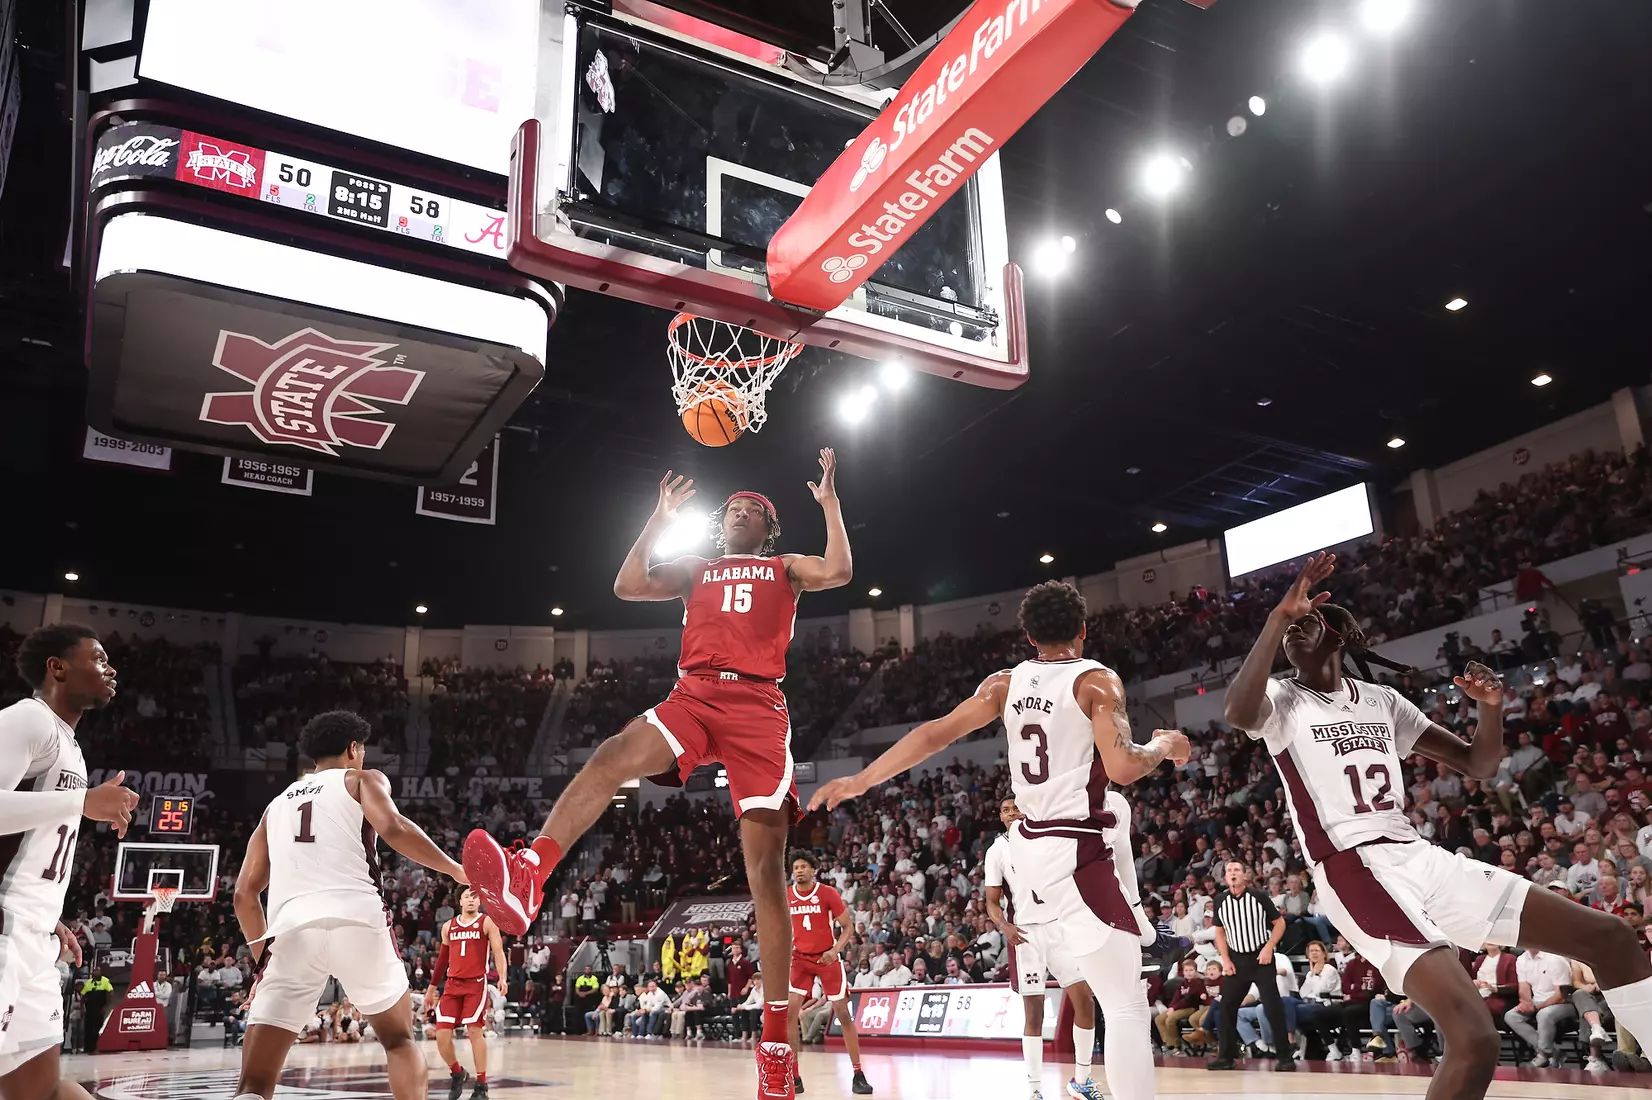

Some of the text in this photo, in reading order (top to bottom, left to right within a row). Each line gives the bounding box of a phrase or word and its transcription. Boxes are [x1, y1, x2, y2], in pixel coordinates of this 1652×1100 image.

[278, 163, 312, 187] 50
[265, 194, 281, 203] FLS
[269, 184, 280, 197] 5
[334, 185, 383, 210] 8:15
[302, 203, 318, 213] TOL
[305, 193, 316, 206] 2
[409, 195, 440, 219] 58
[395, 225, 411, 235] FLS
[398, 216, 408, 228] 9
[433, 224, 443, 236] 2
[430, 233, 446, 244] TOL
[271, 358, 349, 434] STATE
[93, 436, 165, 456] 1999-2003
[238, 458, 301, 477] 1956-1965
[243, 471, 293, 486] HEAD COACH
[430, 491, 485, 508] 1957-1959
[702, 565, 776, 584] ALABAMA
[721, 583, 753, 613] 15
[720, 671, 739, 681] RTR
[1012, 696, 1054, 715] MORE
[1311, 722, 1392, 740] MISSISSIPPI
[1341, 739, 1384, 752] STATE
[1020, 724, 1050, 785] 3
[286, 784, 324, 800] SMTH
[400, 776, 448, 798] HAI
[1343, 764, 1395, 814] 12
[158, 811, 185, 830] 25
[294, 800, 317, 843] 1
[685, 903, 754, 914] MISSISSI
[802, 914, 812, 931] 4
[449, 930, 481, 941] ALABAMA
[459, 940, 467, 957] 1
[901, 996, 916, 1011] 50
[956, 995, 972, 1010] 58
